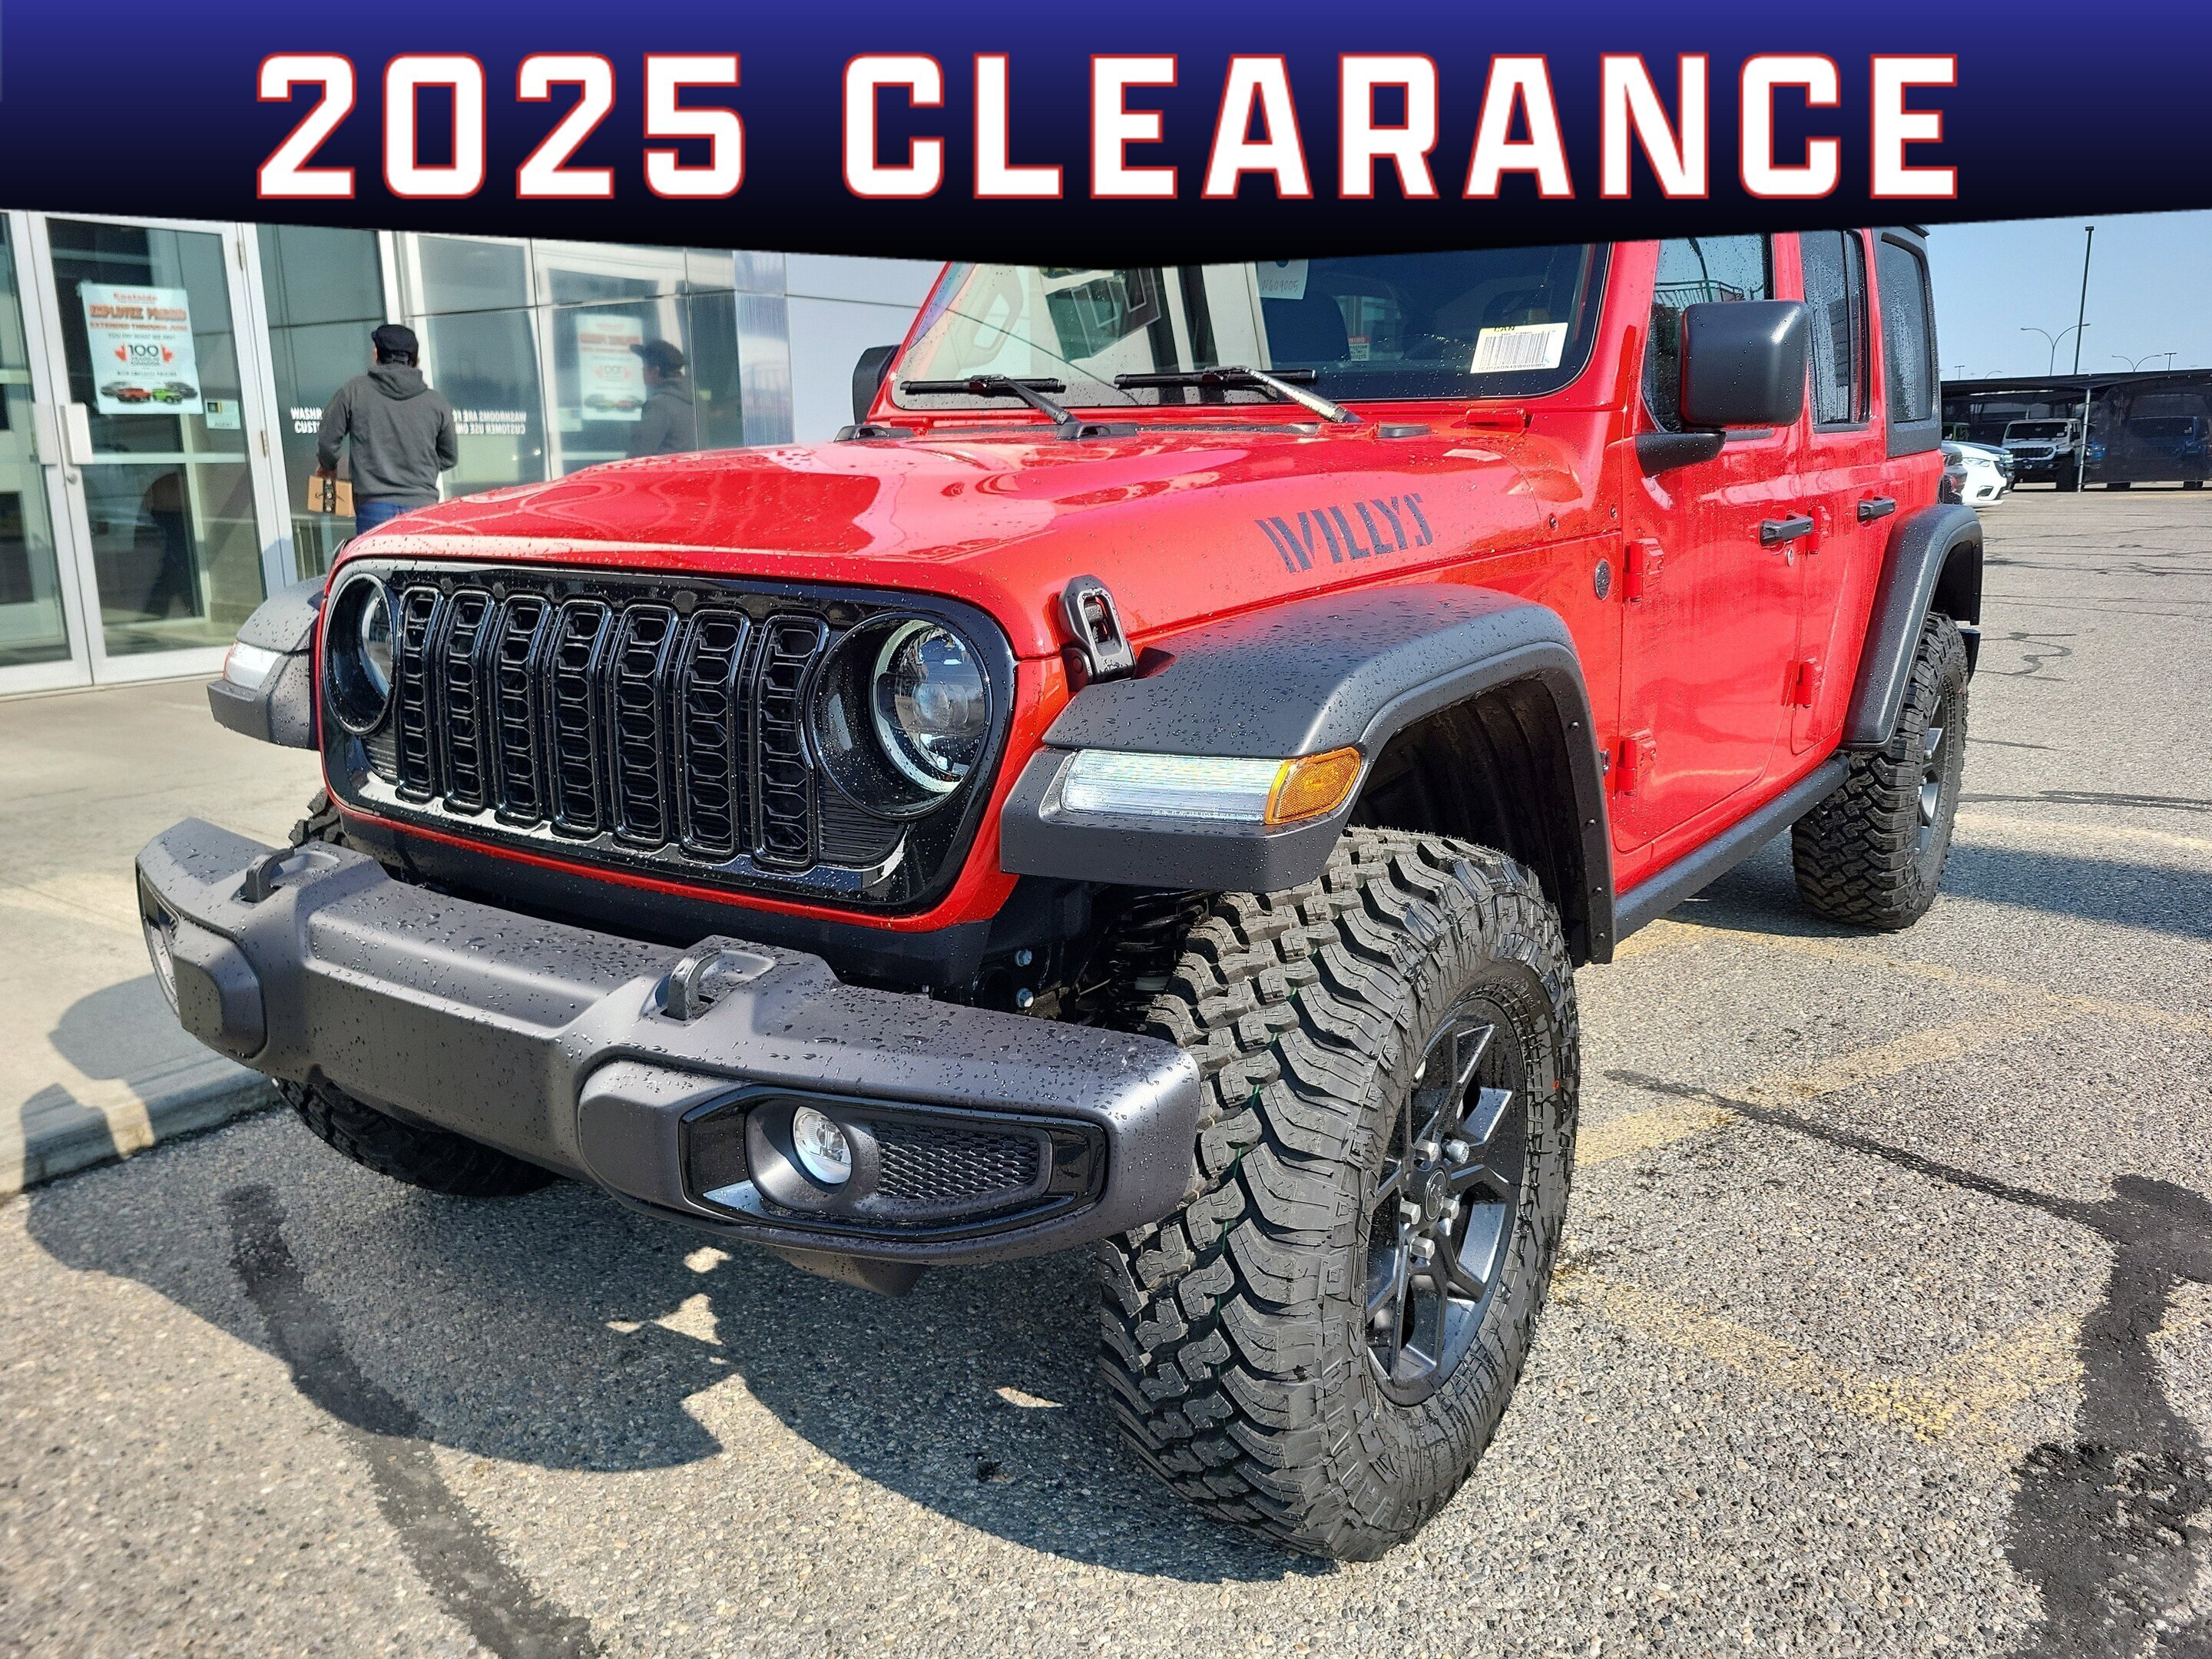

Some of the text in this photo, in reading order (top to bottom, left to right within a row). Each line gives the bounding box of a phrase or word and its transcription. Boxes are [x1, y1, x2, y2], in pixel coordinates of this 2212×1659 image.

[127, 344, 159, 357] 100
[290, 406, 324, 420] WASHR
[1255, 492, 1433, 574] WILLYS
